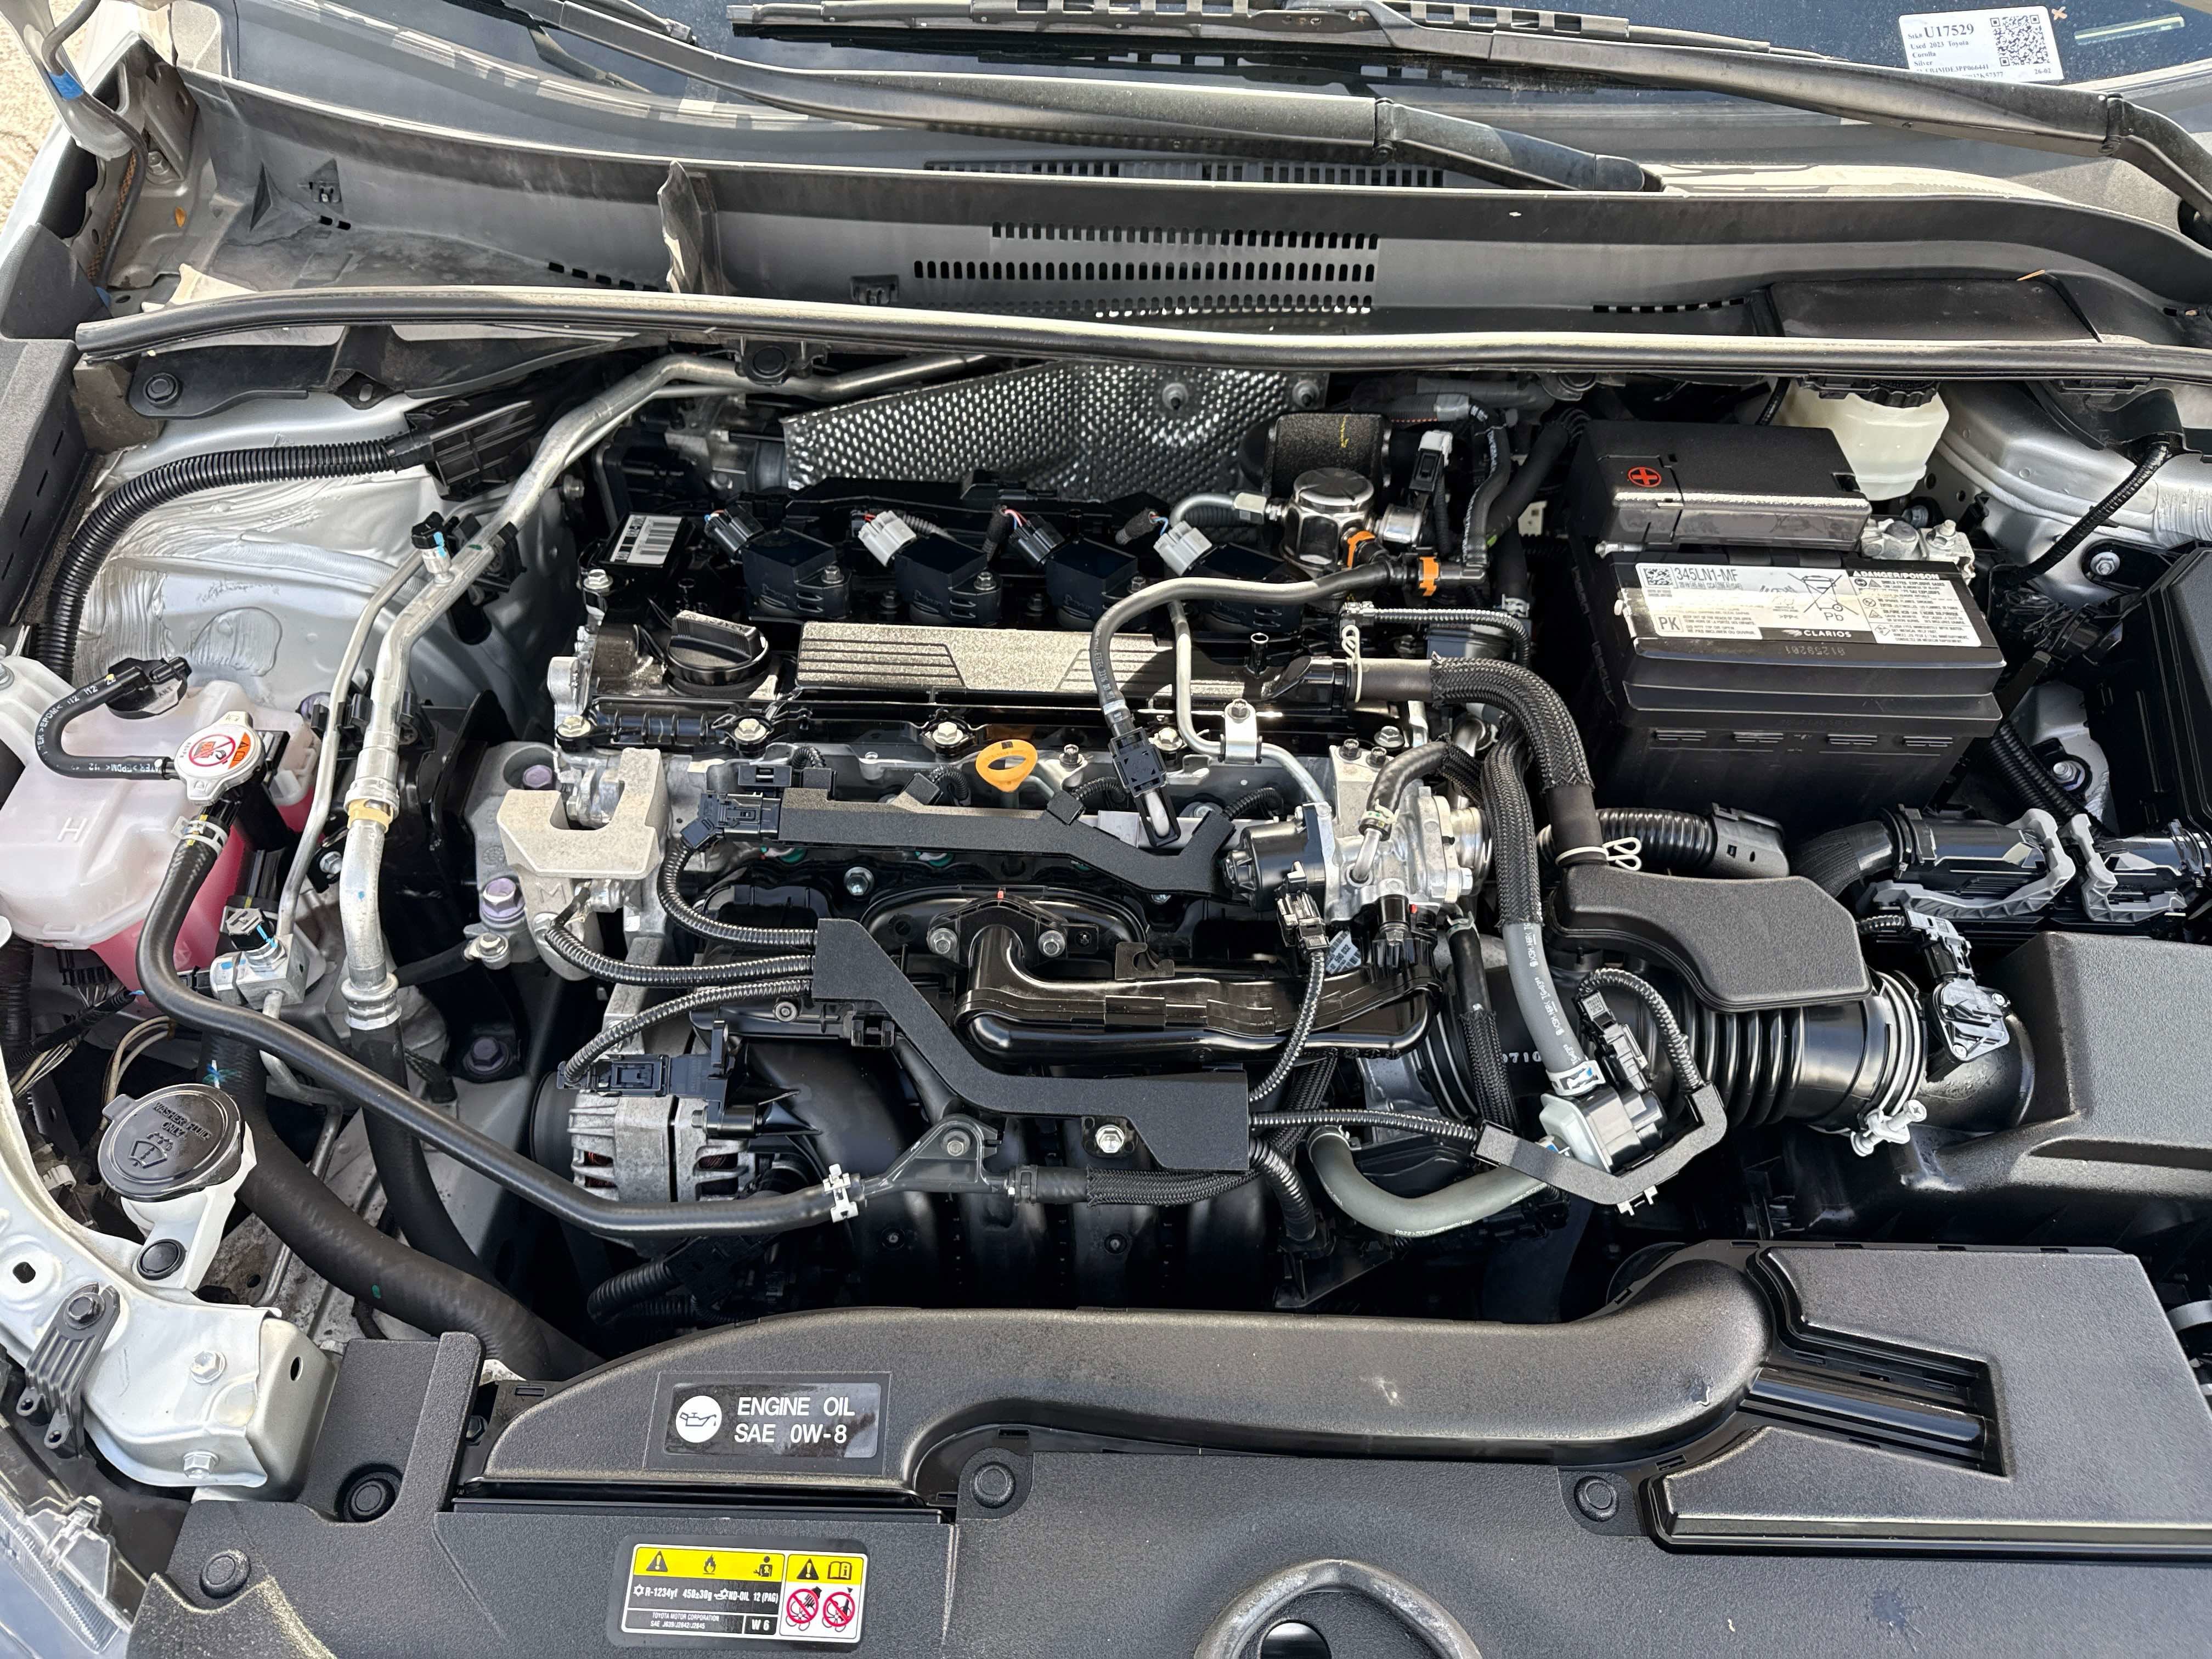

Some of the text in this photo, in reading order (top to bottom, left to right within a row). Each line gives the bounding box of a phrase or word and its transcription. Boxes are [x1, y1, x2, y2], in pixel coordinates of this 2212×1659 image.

[1925, 23, 1974, 38] U17529
[1674, 567, 1739, 582] 345LN1-MF
[1860, 571, 1940, 580] DANGER/POISON
[1658, 617, 1680, 631] PK
[1824, 612, 1844, 622] Pb
[57, 817, 88, 842] H
[535, 882, 567, 905] M
[153, 1102, 213, 1142] WASHER FLUID
[162, 1122, 185, 1138] ONLY
[737, 1396, 855, 1417] ENGINE OIL
[734, 1423, 847, 1444] SAE 0W-8
[645, 1587, 778, 1604] R-1234yf 450±30g ND-OIL 12 (PAG)
[687, 1613, 720, 1622] CORPORATION
[751, 1619, 770, 1630] W 6
